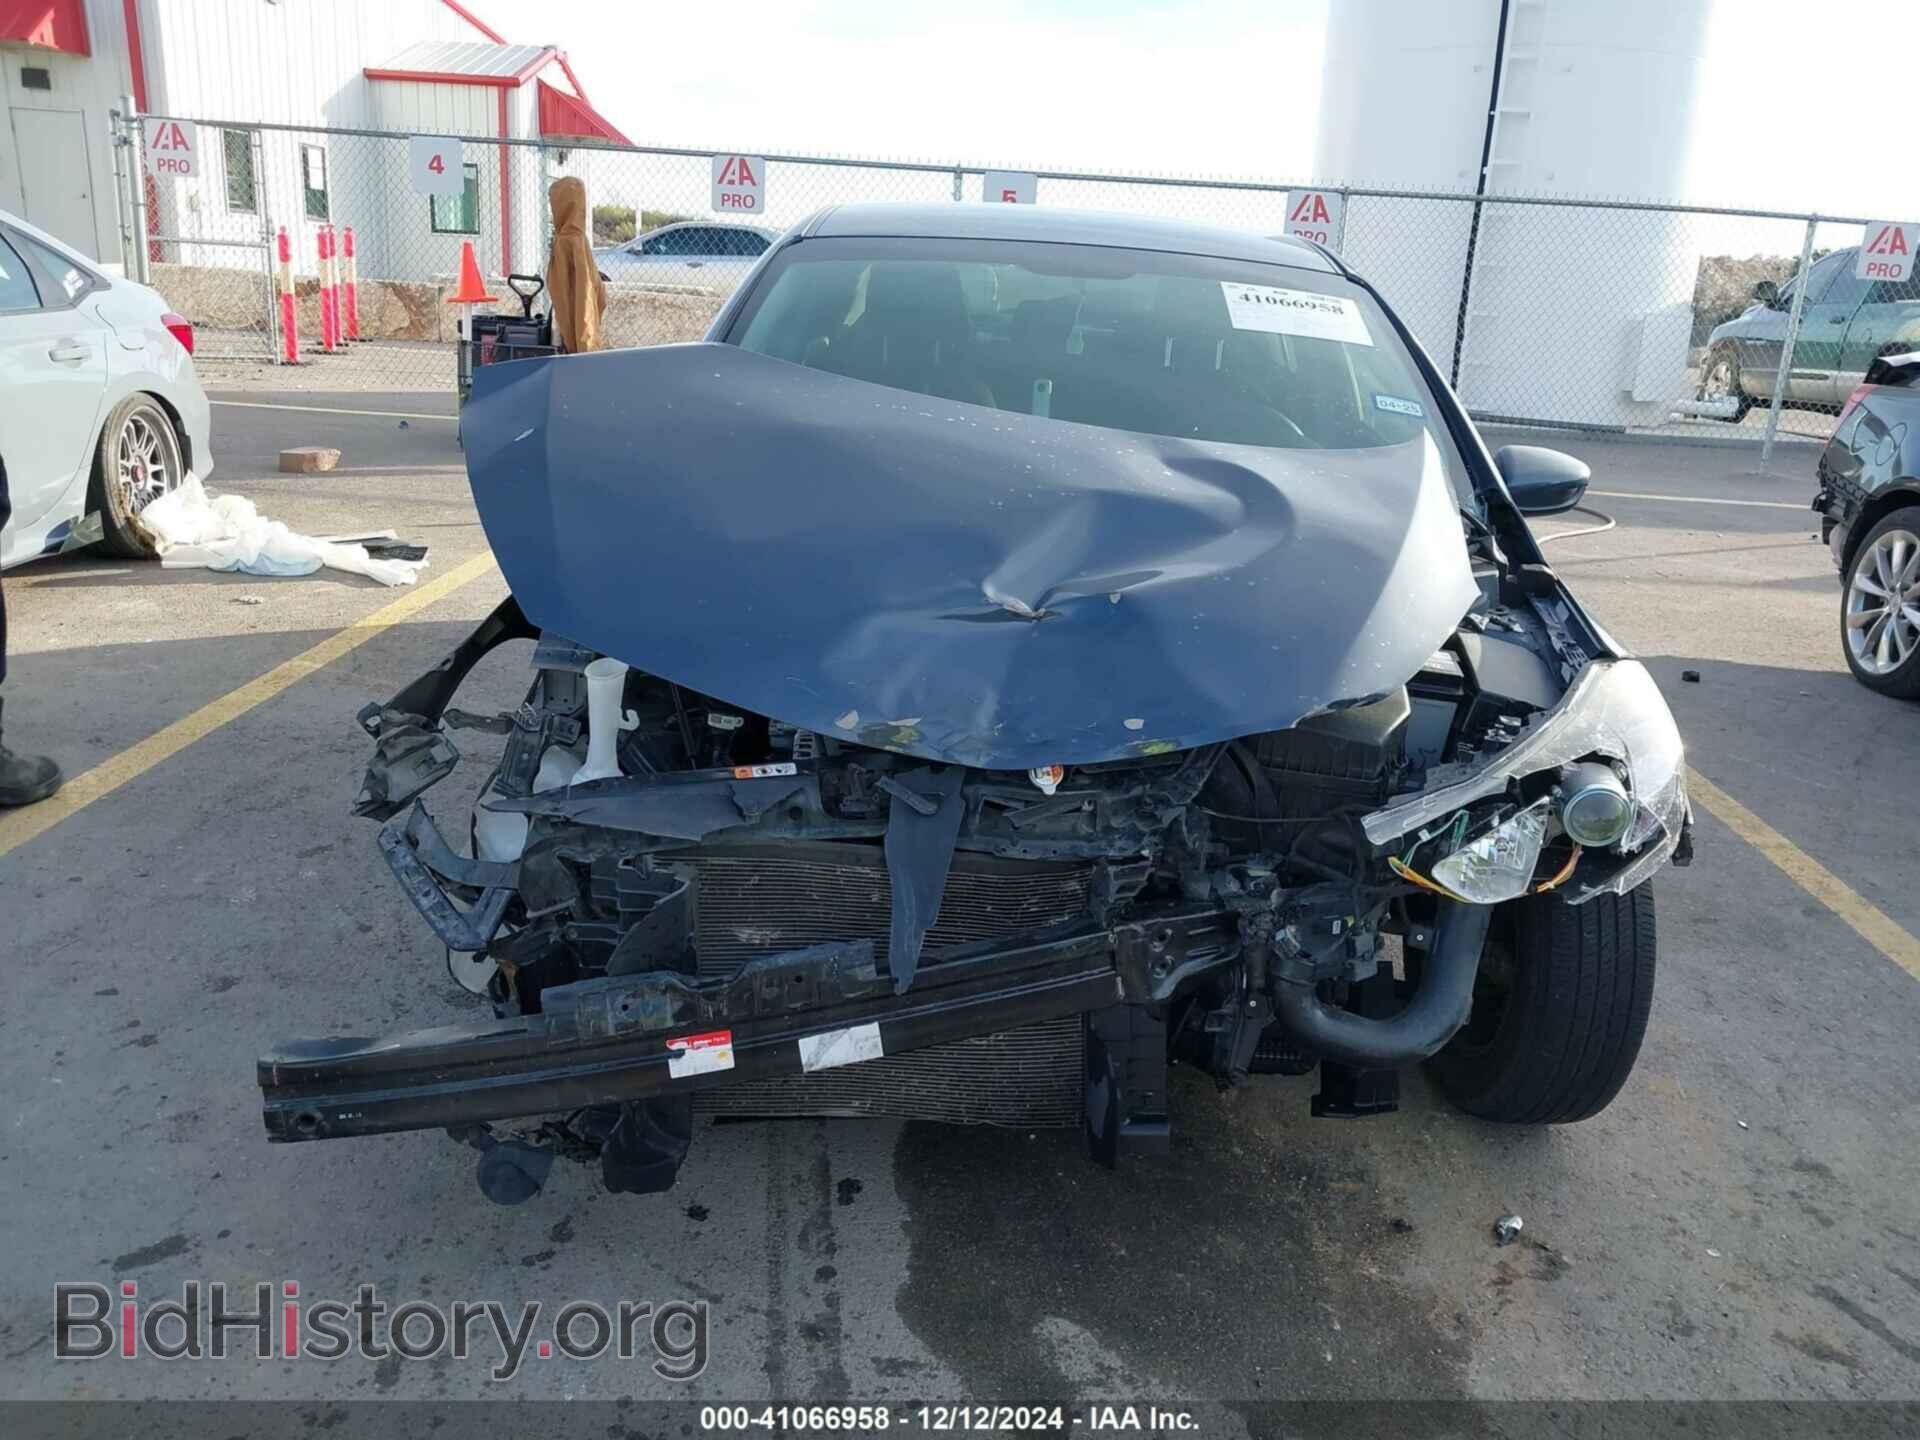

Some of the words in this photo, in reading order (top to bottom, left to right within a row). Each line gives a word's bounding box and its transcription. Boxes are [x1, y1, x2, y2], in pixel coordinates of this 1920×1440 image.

[157, 158, 191, 174] PRO
[428, 154, 445, 175] 4
[721, 193, 755, 209] PRO
[1002, 190, 1017, 204] 5
[1866, 262, 1902, 278] PRO
[1240, 293, 1344, 314] 41066958
